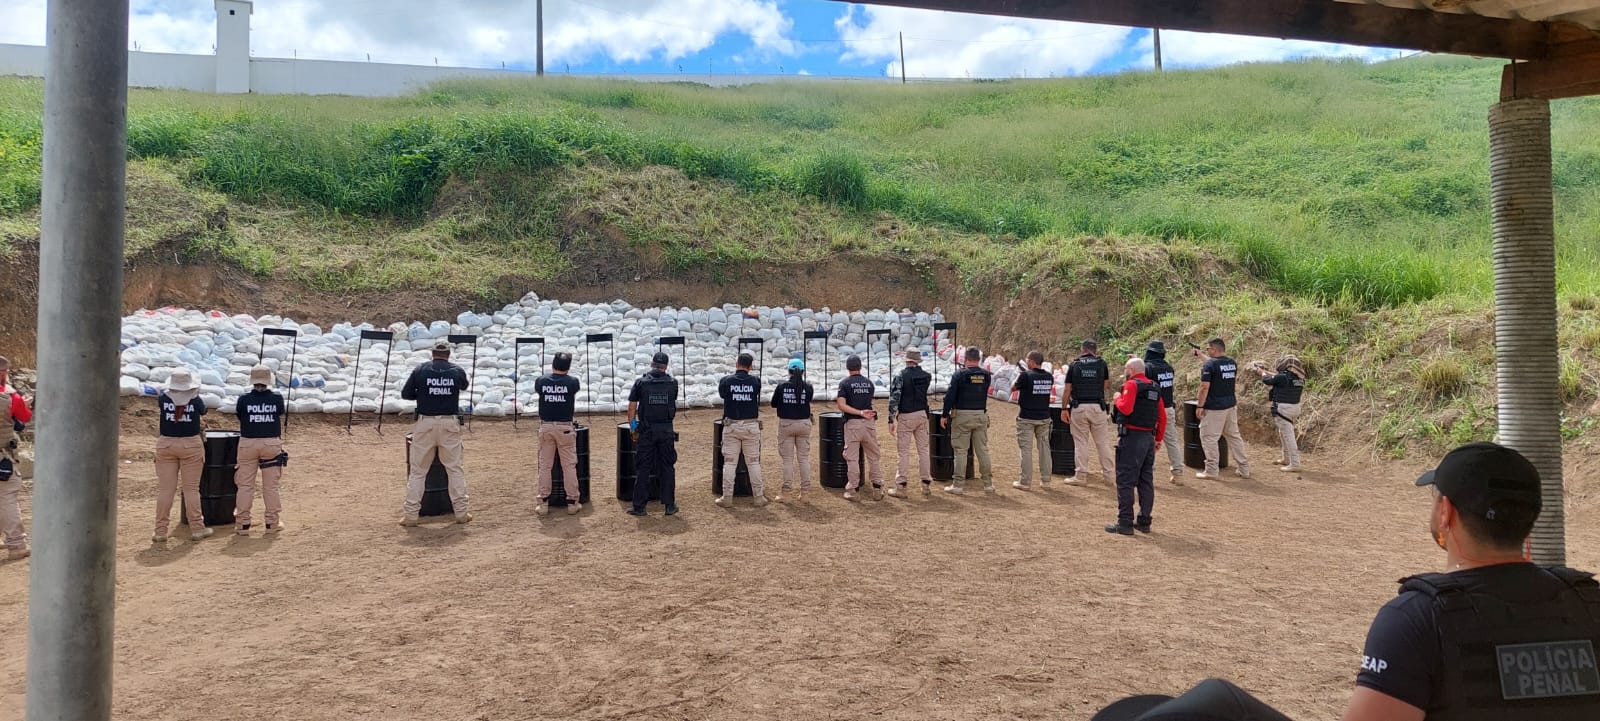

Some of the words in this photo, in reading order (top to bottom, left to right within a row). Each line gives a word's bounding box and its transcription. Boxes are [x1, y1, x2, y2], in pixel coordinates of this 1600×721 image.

[426, 377, 454, 386] POLÍCIA
[429, 387, 452, 395] PENAL
[542, 385, 568, 394] POLÍCIA
[730, 384, 754, 393] POLÍCIA
[732, 393, 752, 401] PENAL
[247, 402, 277, 413] POLÍCIA
[166, 413, 192, 422] PEAL
[249, 414, 275, 423] PENAL
[1501, 645, 1593, 673] POLÍCIA
[1518, 671, 1586, 696] PENAL
